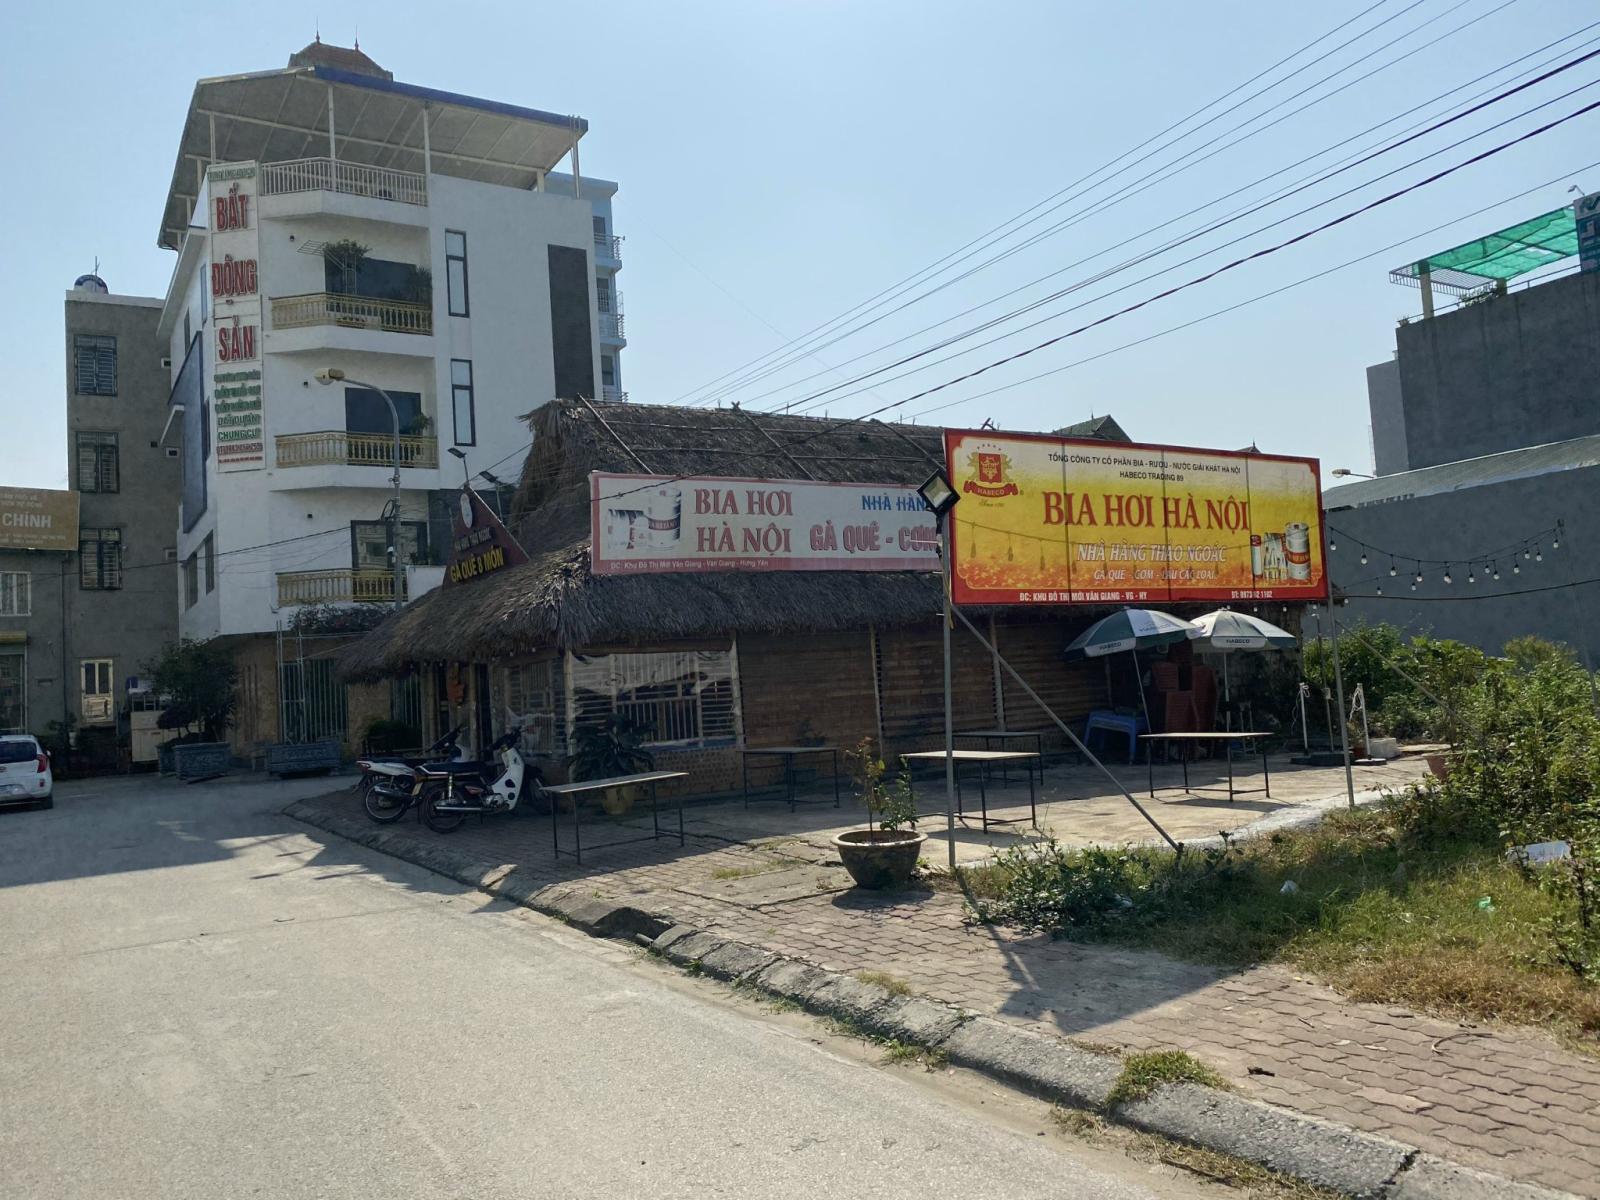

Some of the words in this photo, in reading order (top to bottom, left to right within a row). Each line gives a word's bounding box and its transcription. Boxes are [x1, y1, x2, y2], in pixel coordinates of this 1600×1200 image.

[216, 182, 249, 231] BẤT
[212, 254, 258, 305] ĐỘNG
[219, 315, 255, 361] SẢN
[218, 430, 247, 442] CHUNG
[1070, 454, 1091, 464] CÔNG
[1092, 456, 1100, 465] TY
[1133, 459, 1144, 467] BIA
[1119, 471, 1147, 480] HABECO
[1148, 472, 1175, 482] TRADING
[694, 488, 739, 514] BIA
[745, 490, 793, 516] HƠI
[862, 492, 891, 511] NHÀ
[896, 493, 926, 511] HÀN
[1042, 491, 1097, 526] BIA
[1102, 493, 1155, 528] HƠI
[1161, 492, 1201, 529] HÀ
[1206, 495, 1250, 535] NỘI
[696, 521, 736, 552] HÀ
[742, 522, 792, 556] NỘI
[809, 519, 838, 551] GÀ
[843, 521, 881, 554] QUÊ
[898, 524, 938, 552] CƠM
[1077, 537, 1106, 561] NHÀ
[1110, 537, 1147, 561] HÀNG
[624, 561, 637, 569] Khu
[1019, 592, 1032, 601] ĐC:
[1033, 592, 1047, 601] KHU
[1085, 590, 1099, 601] VĂN
[1100, 591, 1120, 601] GIANG
[1125, 591, 1134, 600] VG
